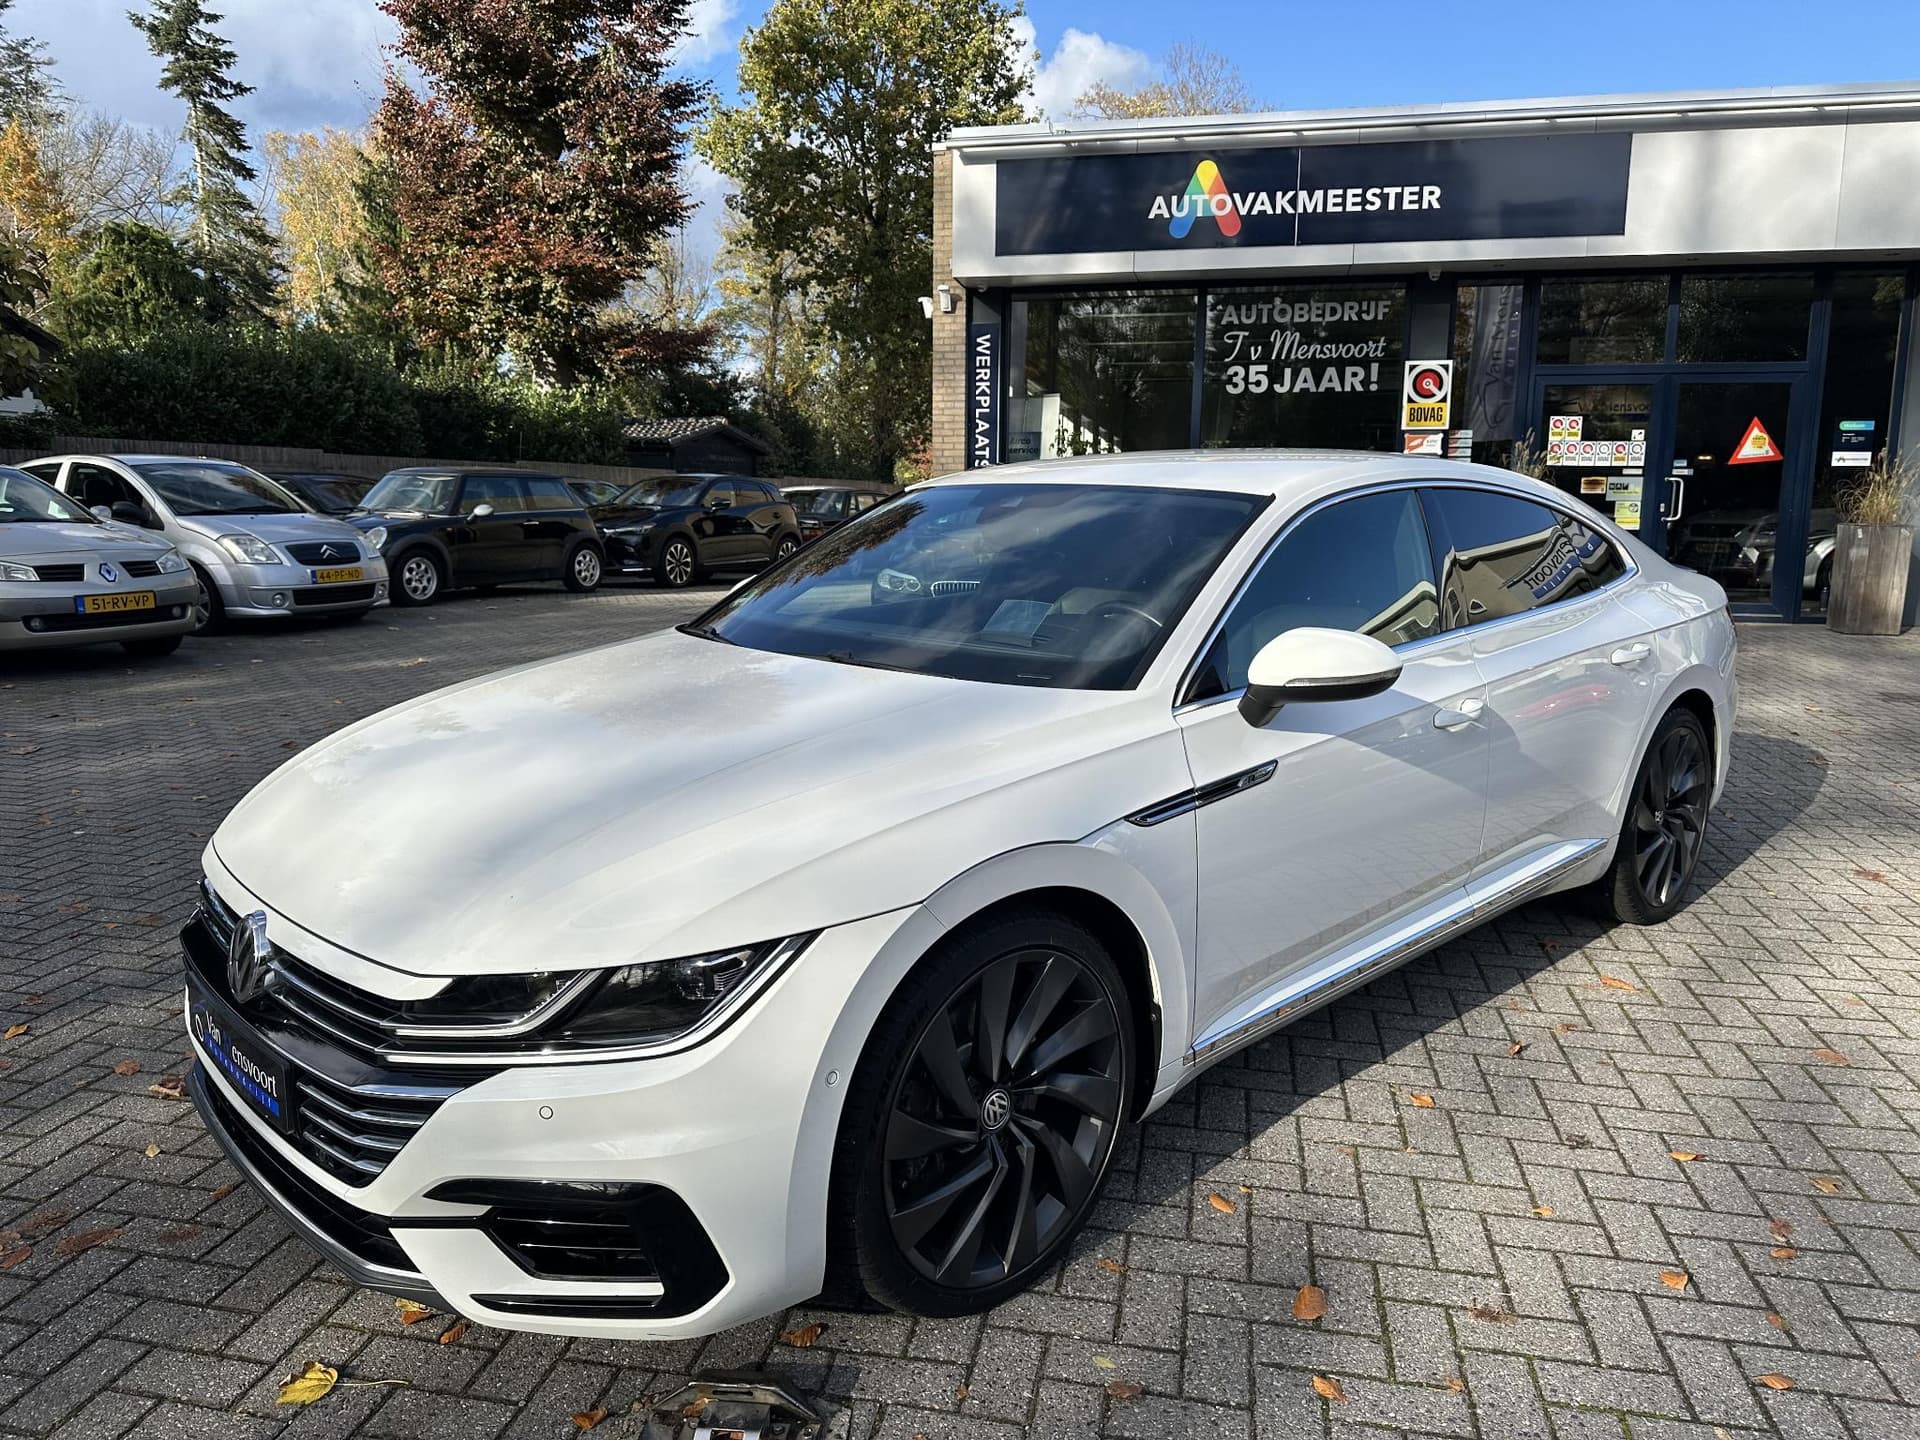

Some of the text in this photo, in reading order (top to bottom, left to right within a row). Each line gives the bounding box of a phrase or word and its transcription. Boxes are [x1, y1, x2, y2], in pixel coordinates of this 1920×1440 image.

[1147, 185, 1442, 220] AUTOVAKMEESTER
[1220, 301, 1392, 325] AUTOBEDRIJF
[1223, 329, 1387, 362] T v Mensvoort
[1225, 362, 1379, 394] 35 JAAR!
[1409, 407, 1443, 422] BOVAG
[91, 595, 149, 610] 51-RV-VP
[205, 1010, 222, 1046] Van
